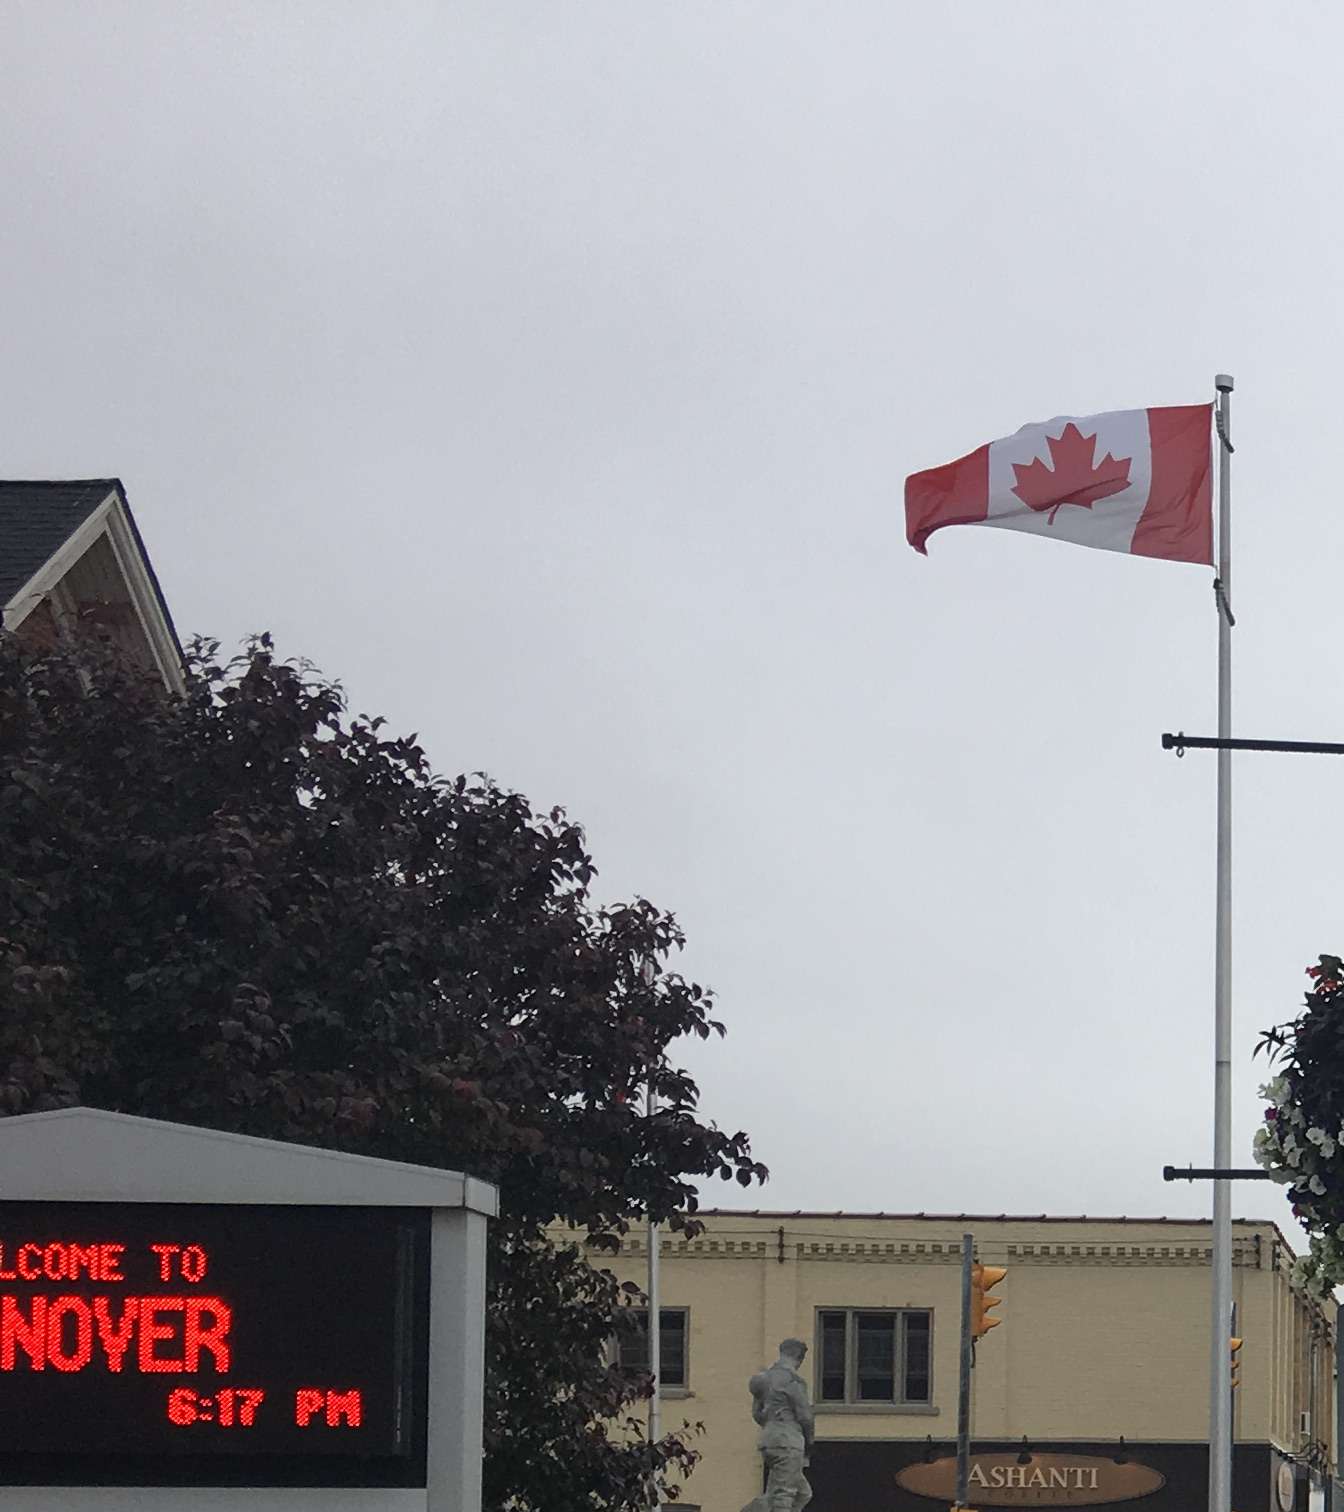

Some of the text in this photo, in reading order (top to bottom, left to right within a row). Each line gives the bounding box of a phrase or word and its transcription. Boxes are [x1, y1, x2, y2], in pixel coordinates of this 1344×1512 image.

[151, 1243, 209, 1283] TO
[0, 1295, 233, 1373] NOVER
[168, 1388, 362, 1428] 6:17 PM
[967, 1463, 1100, 1489] ASHANTI
